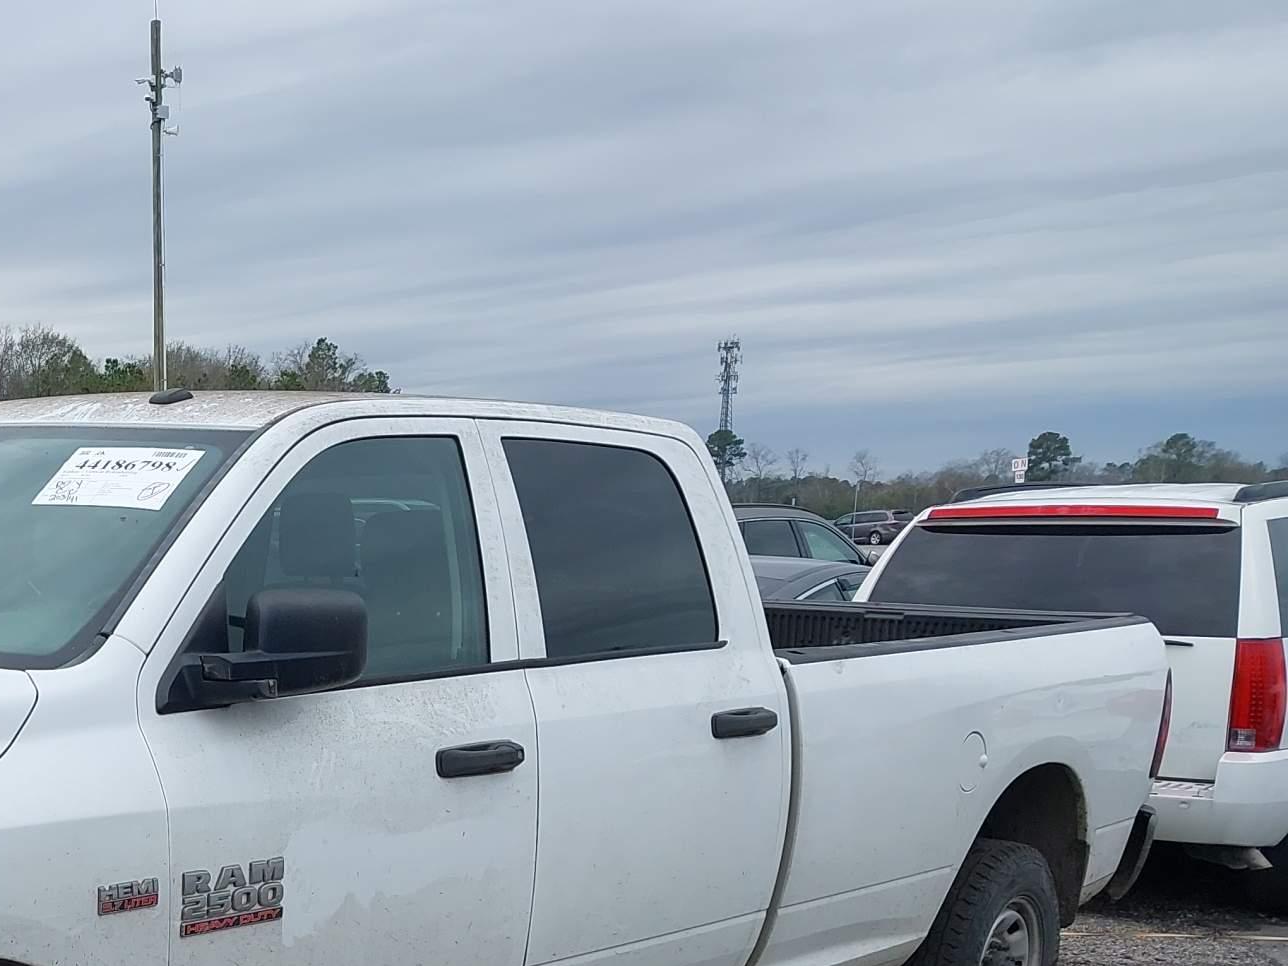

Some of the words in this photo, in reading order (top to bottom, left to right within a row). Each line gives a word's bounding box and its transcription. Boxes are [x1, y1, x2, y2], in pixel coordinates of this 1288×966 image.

[75, 459, 177, 472] 44186798
[182, 856, 285, 895] RAM
[98, 878, 159, 902] HEMI
[181, 882, 284, 920] 2500
[186, 916, 236, 935] HEAVY
[239, 908, 281, 925] DUTY
